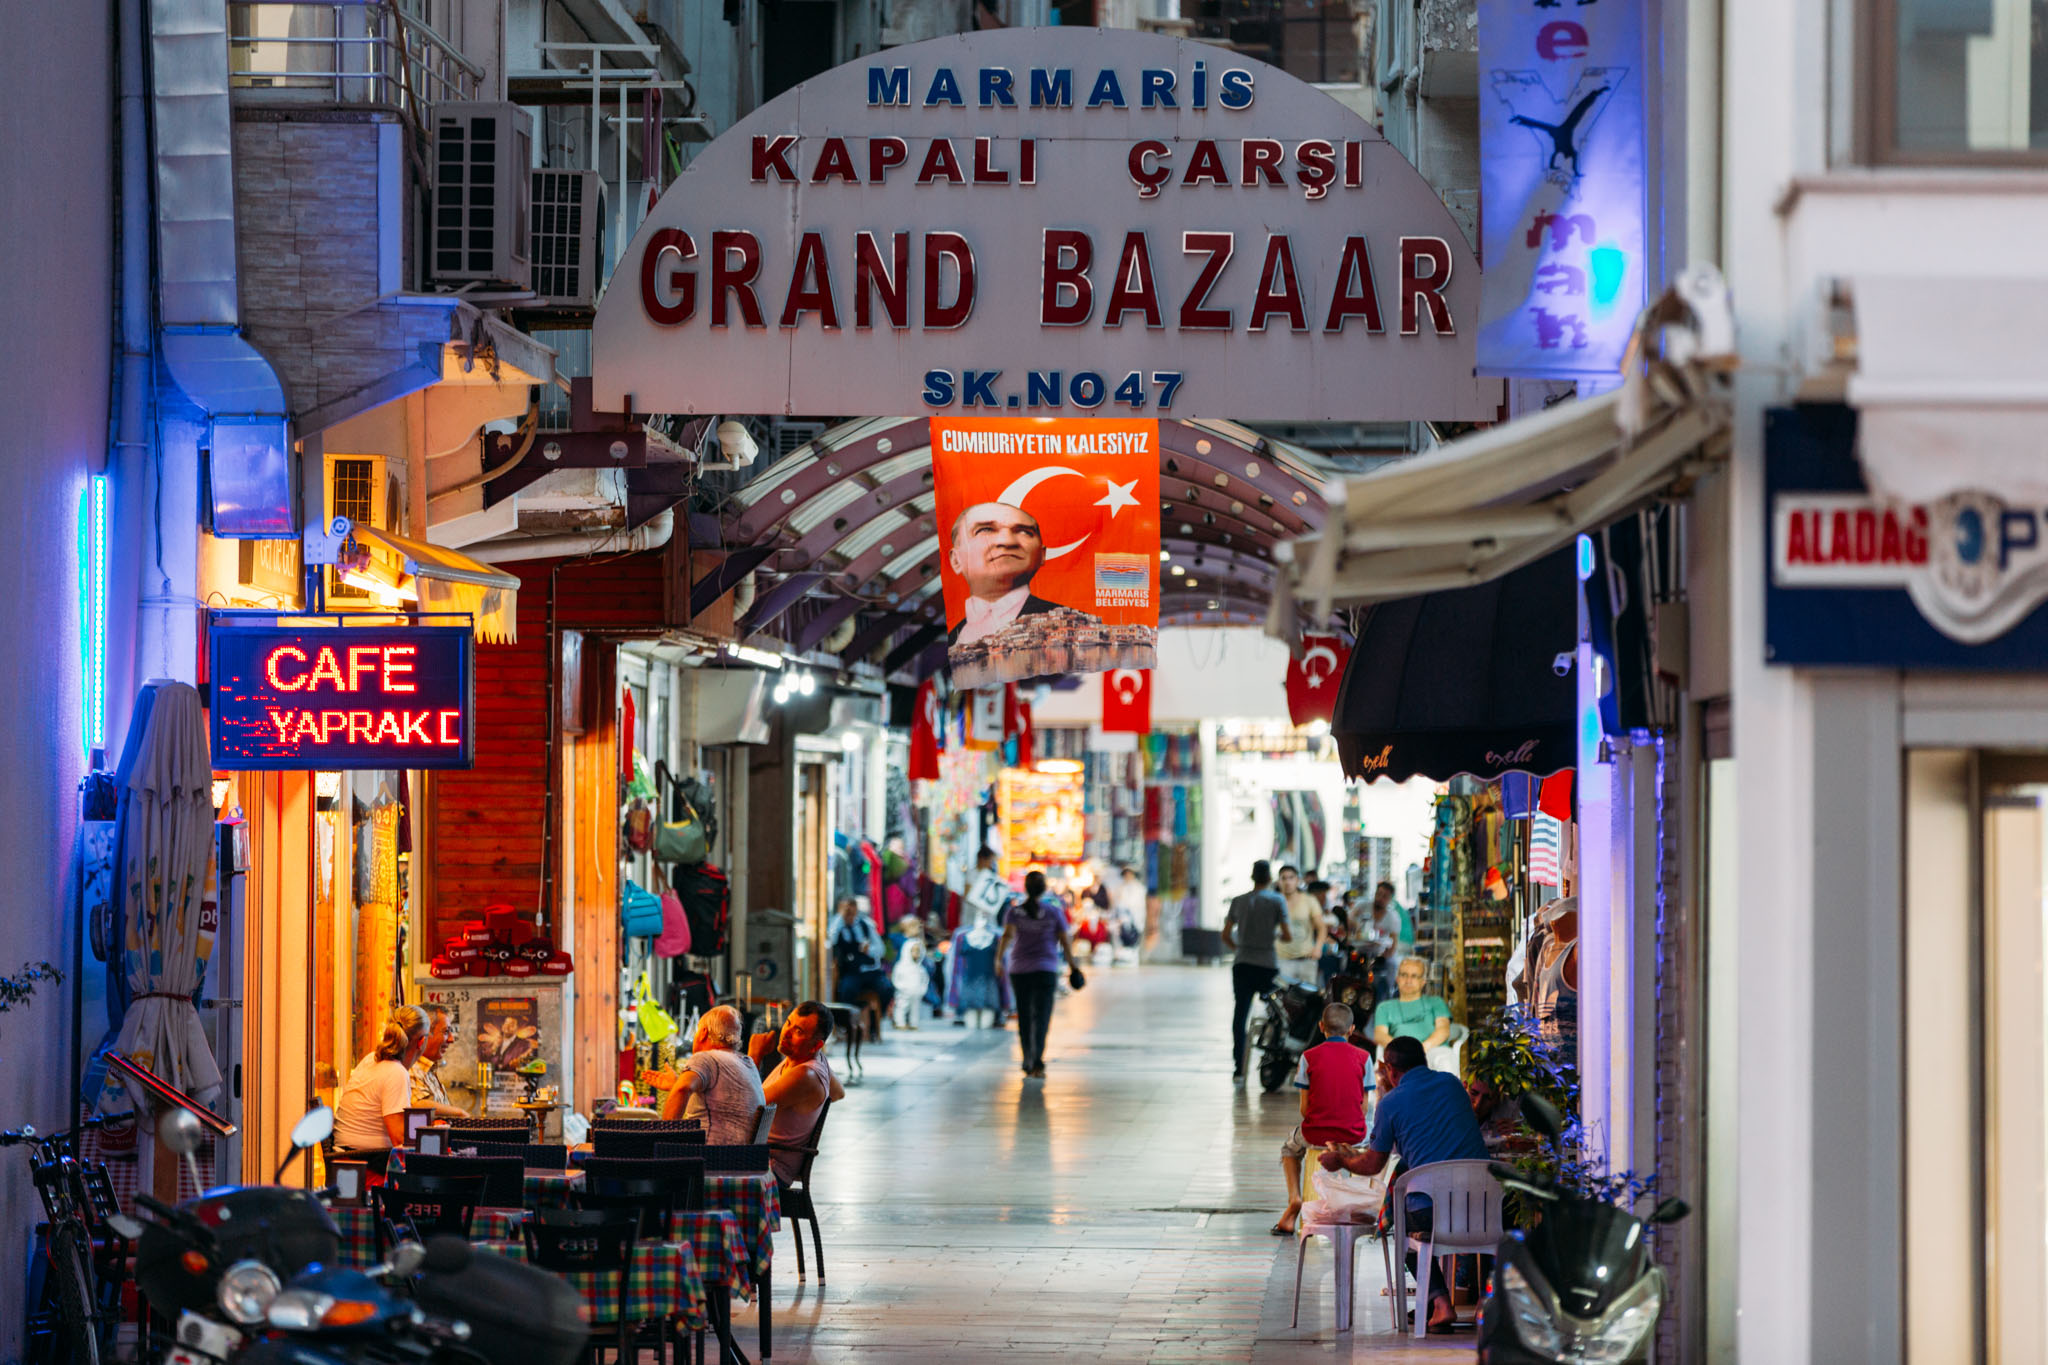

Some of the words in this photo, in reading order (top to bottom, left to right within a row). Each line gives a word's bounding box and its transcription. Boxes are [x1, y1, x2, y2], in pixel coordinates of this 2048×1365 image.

[867, 60, 1257, 110] MARMARİS
[749, 135, 1038, 187] KAPALI
[1127, 138, 1363, 199] ÇARŞI
[640, 226, 979, 331] GRAND
[1040, 227, 1456, 336] BAZAAR
[264, 645, 417, 694] CAFE
[268, 710, 433, 745] YAPRAK
